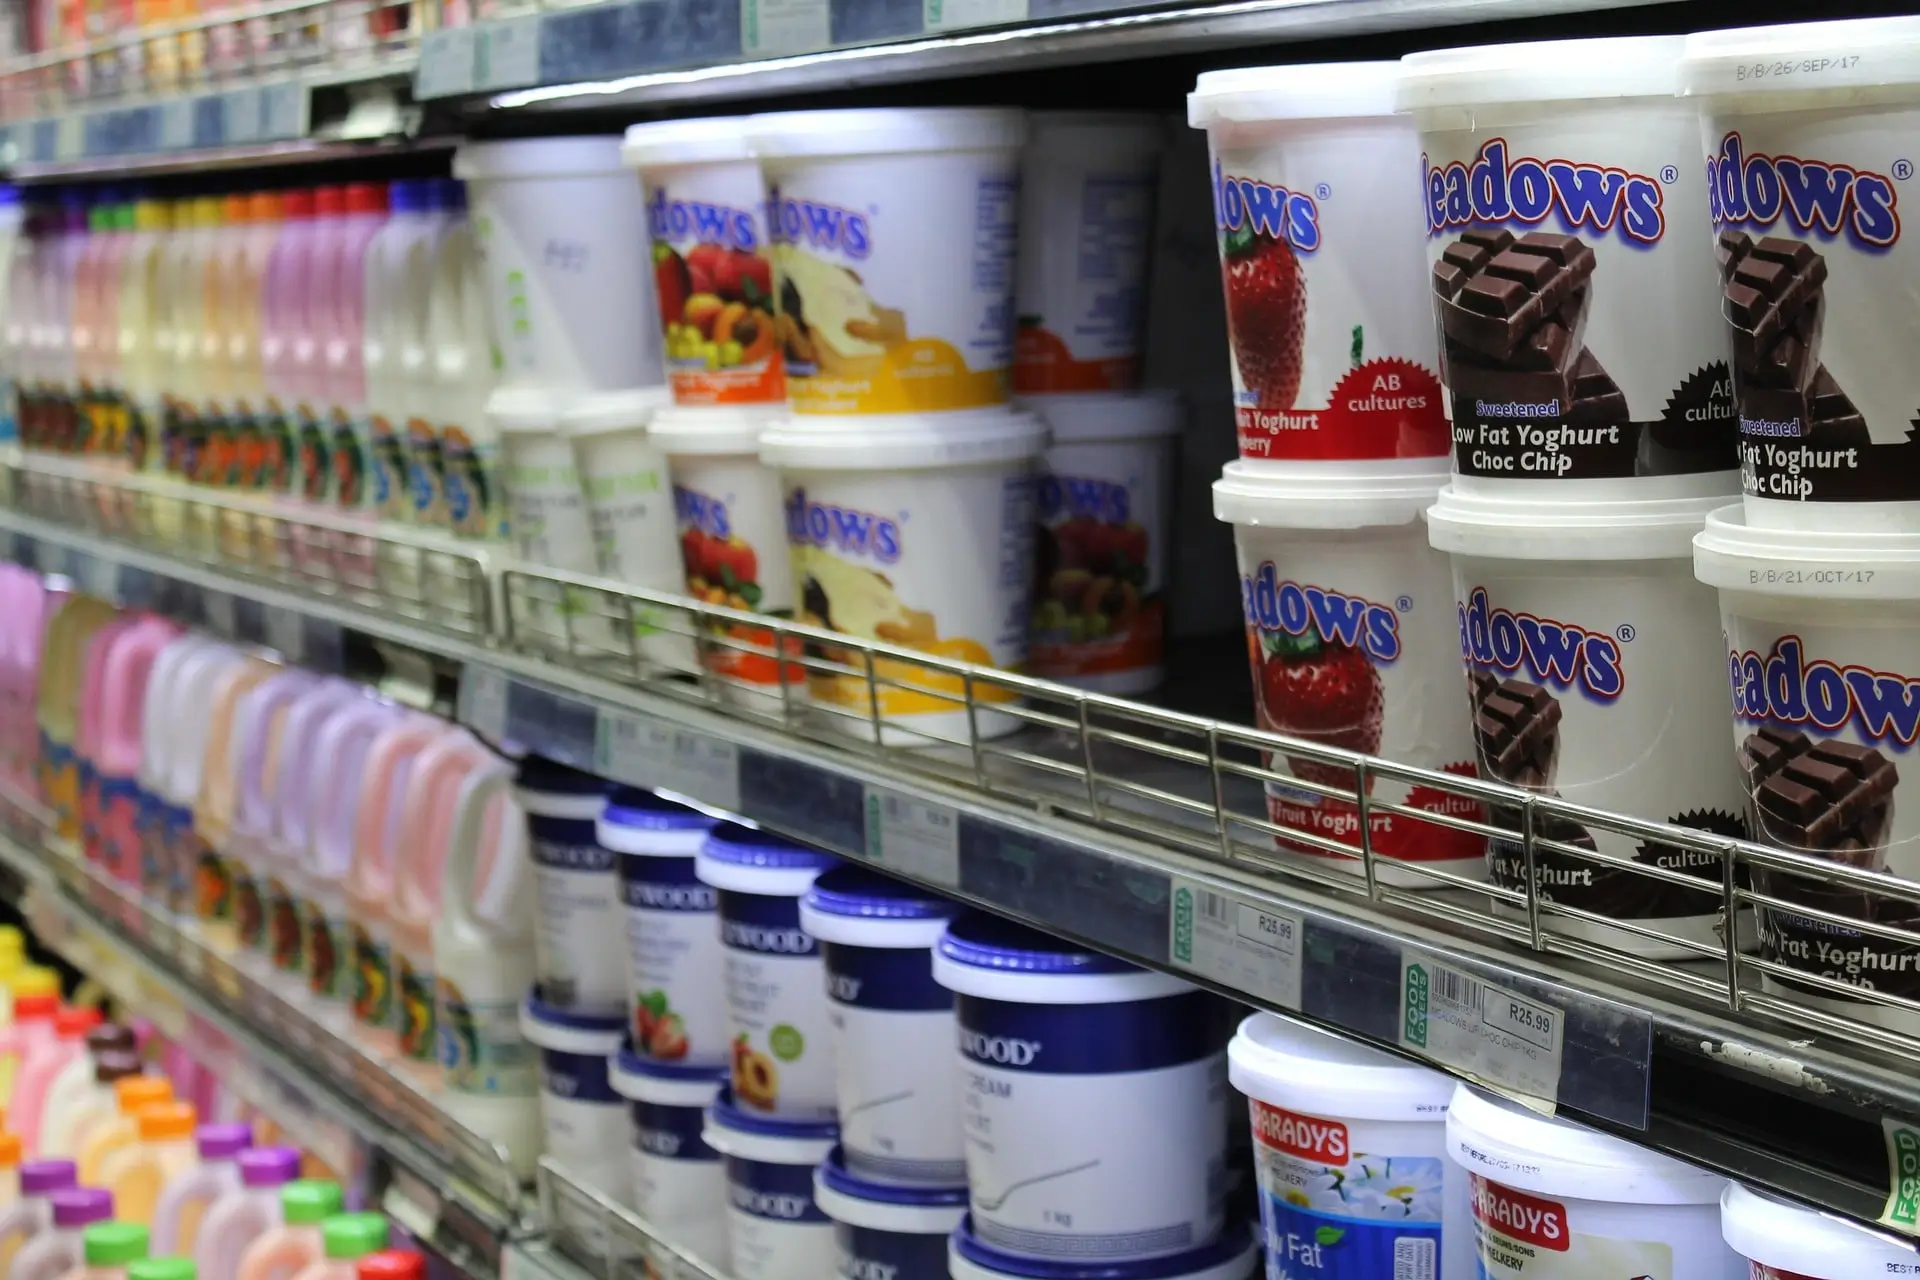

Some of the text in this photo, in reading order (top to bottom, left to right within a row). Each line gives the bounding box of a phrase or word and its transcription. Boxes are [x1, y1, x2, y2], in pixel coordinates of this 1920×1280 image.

[1737, 56, 1859, 82] B/B/26/SEP/17
[1371, 374, 1401, 392] AB
[1348, 393, 1426, 412] cultures
[1476, 399, 1560, 417] Sweetened
[1252, 411, 1319, 435] Yoghurt
[1480, 424, 1509, 445] Fat
[1516, 424, 1619, 452] Yoghurt
[1472, 451, 1572, 476] Choc Chip
[1742, 441, 1858, 475] Fat Yoghurt
[1741, 469, 1813, 501] Choc Chip
[1750, 570, 1875, 584] B/B/21/OCT/17
[1722, 631, 1920, 745] eadow
[1312, 810, 1392, 836] Yoghrt
[1259, 915, 1291, 939] R25.99
[1780, 931, 1809, 959] Fat
[1407, 969, 1418, 1040] FOOD
[1418, 975, 1427, 1044] LOVER'S
[1510, 1003, 1550, 1033] R25.99
[1896, 1133, 1917, 1218] FOOD
[1287, 1231, 1324, 1270] Fat
